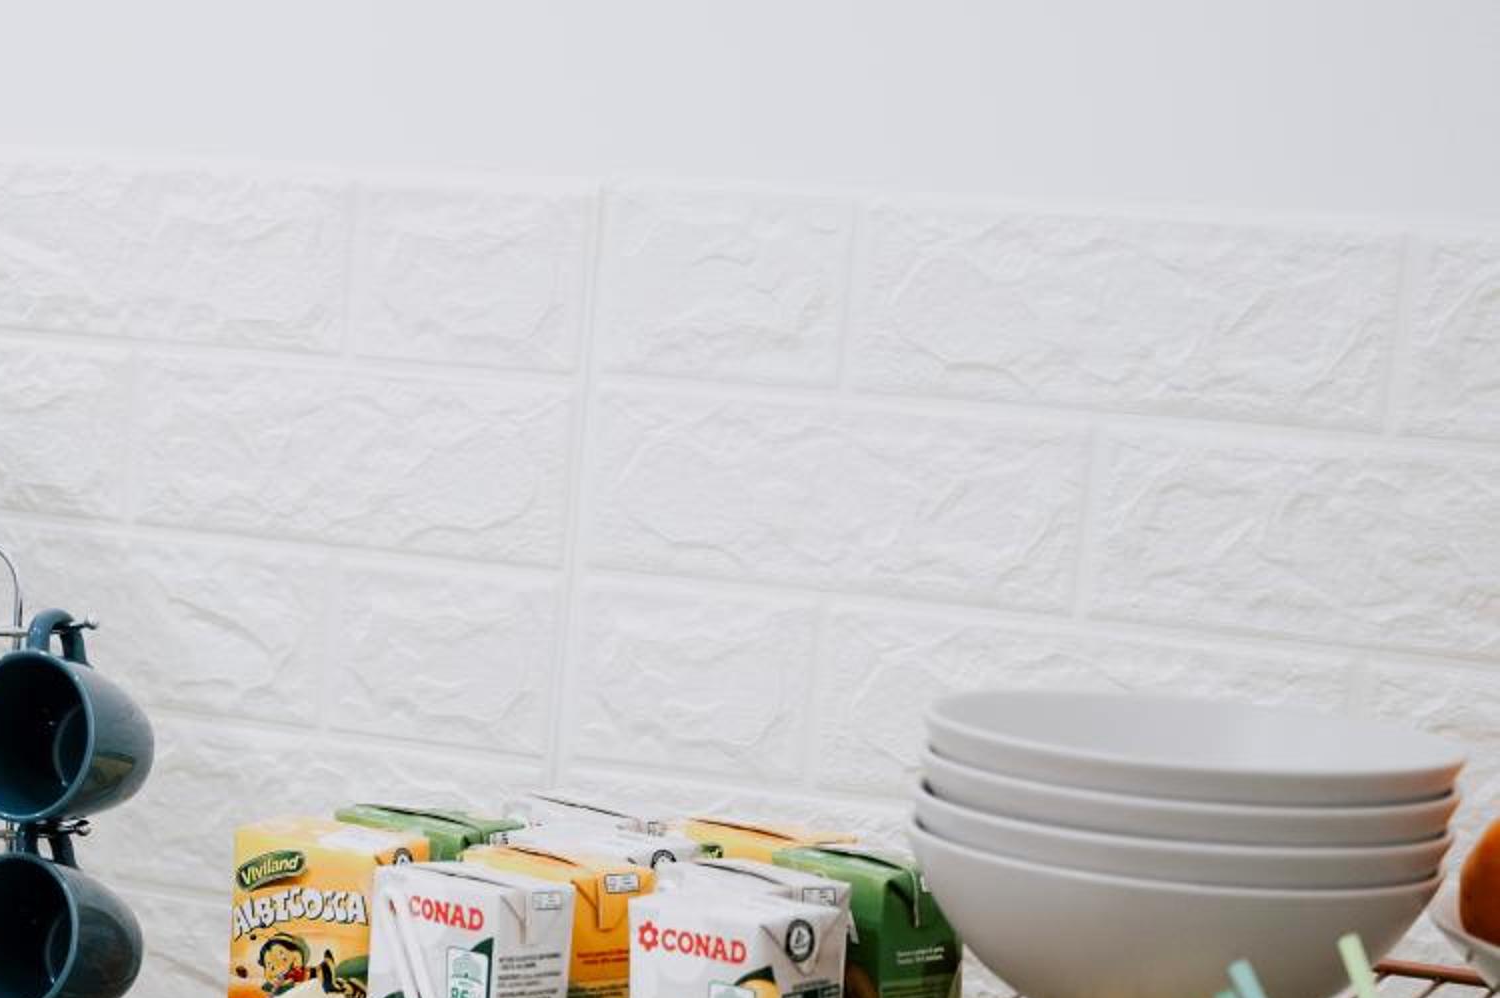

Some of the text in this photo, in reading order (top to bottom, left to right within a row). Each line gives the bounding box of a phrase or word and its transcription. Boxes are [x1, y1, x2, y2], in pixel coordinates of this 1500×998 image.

[241, 856, 299, 885] Viviland
[233, 887, 369, 939] ALBICOCCA
[409, 895, 485, 931] CONAD
[661, 928, 747, 965] CONAD
